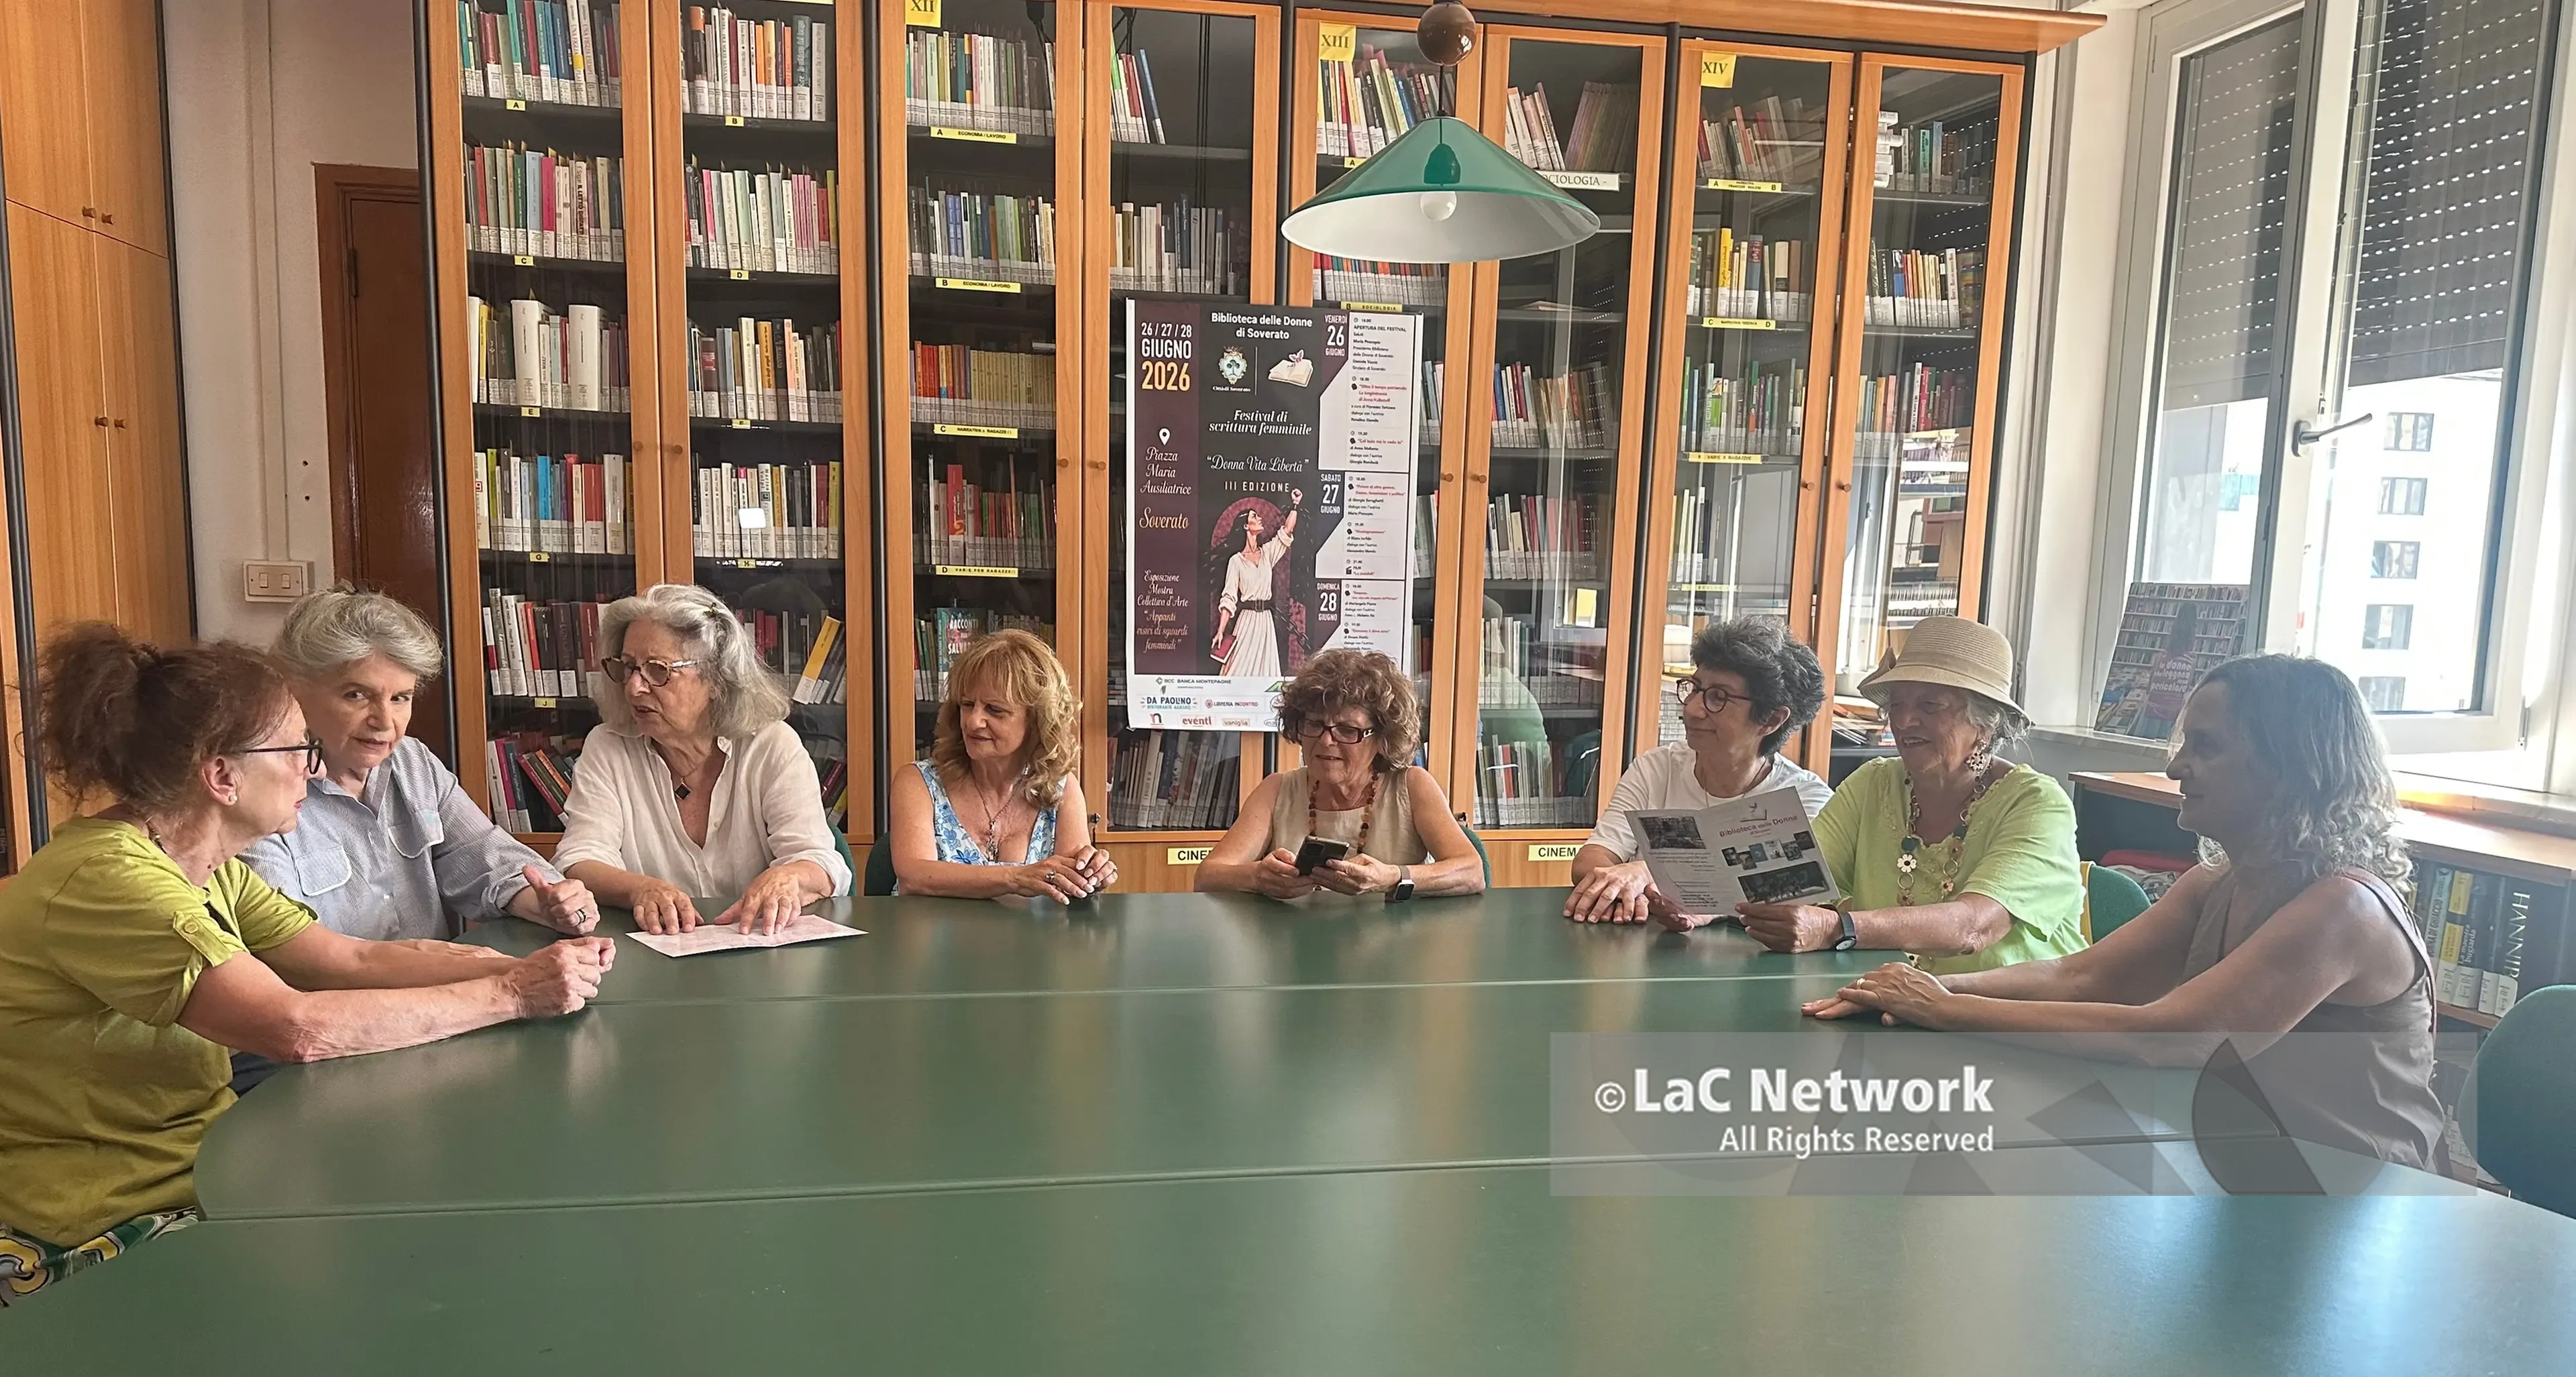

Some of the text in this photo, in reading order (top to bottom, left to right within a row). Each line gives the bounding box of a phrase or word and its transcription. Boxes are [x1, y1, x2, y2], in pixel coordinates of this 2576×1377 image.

[911, 0, 934, 13] XII
[1321, 34, 1349, 48] XIII
[1703, 62, 1727, 74] XIV
[1543, 175, 1601, 186] OCIOLOGIA
[1212, 313, 1313, 327] Biblioteca delle Donne
[1325, 314, 1347, 323] VENERDÌ
[1141, 323, 1152, 336] 26
[1161, 323, 1172, 337] 27
[1181, 325, 1192, 337] 28
[1236, 327, 1289, 339] di Soverato
[1327, 326, 1345, 346] 26
[1141, 338, 1192, 360] GIUGNO
[1326, 347, 1345, 357] GIUGNO
[1141, 361, 1191, 391] 2026
[1234, 410, 1288, 423] Festival di
[1208, 421, 1312, 436] scrittura femminile
[1145, 446, 1179, 461] Piazza
[1246, 455, 1267, 471] Vita
[1145, 463, 1176, 478] Maria
[1320, 474, 1341, 482] SABATO
[1140, 480, 1191, 494] Ausiliatrice
[1225, 481, 1289, 492] III EDIZIONE
[1322, 484, 1339, 504] 27
[1320, 505, 1340, 514] GIUGNO
[1139, 507, 1189, 529] Soverato
[1144, 569, 1180, 584] Esposizione
[1148, 584, 1173, 594] Mostra
[1317, 582, 1340, 591] DOMENICA
[1137, 594, 1165, 606] Collettiva
[1320, 592, 1337, 612] 28
[950, 618, 978, 629] RACCONTI
[1318, 613, 1338, 621] GIUGNO
[1154, 624, 1161, 636] di
[1162, 624, 1188, 639] sguardi
[2166, 659, 2192, 671] donne
[1719, 825, 1757, 837] Biblioteca
[1772, 816, 1798, 825] Donne
[1538, 847, 1579, 858] CINEM
[2429, 899, 2443, 928] GHIACCIO
[2461, 924, 2470, 953] maestra
[2465, 930, 2476, 962] bugiarda
